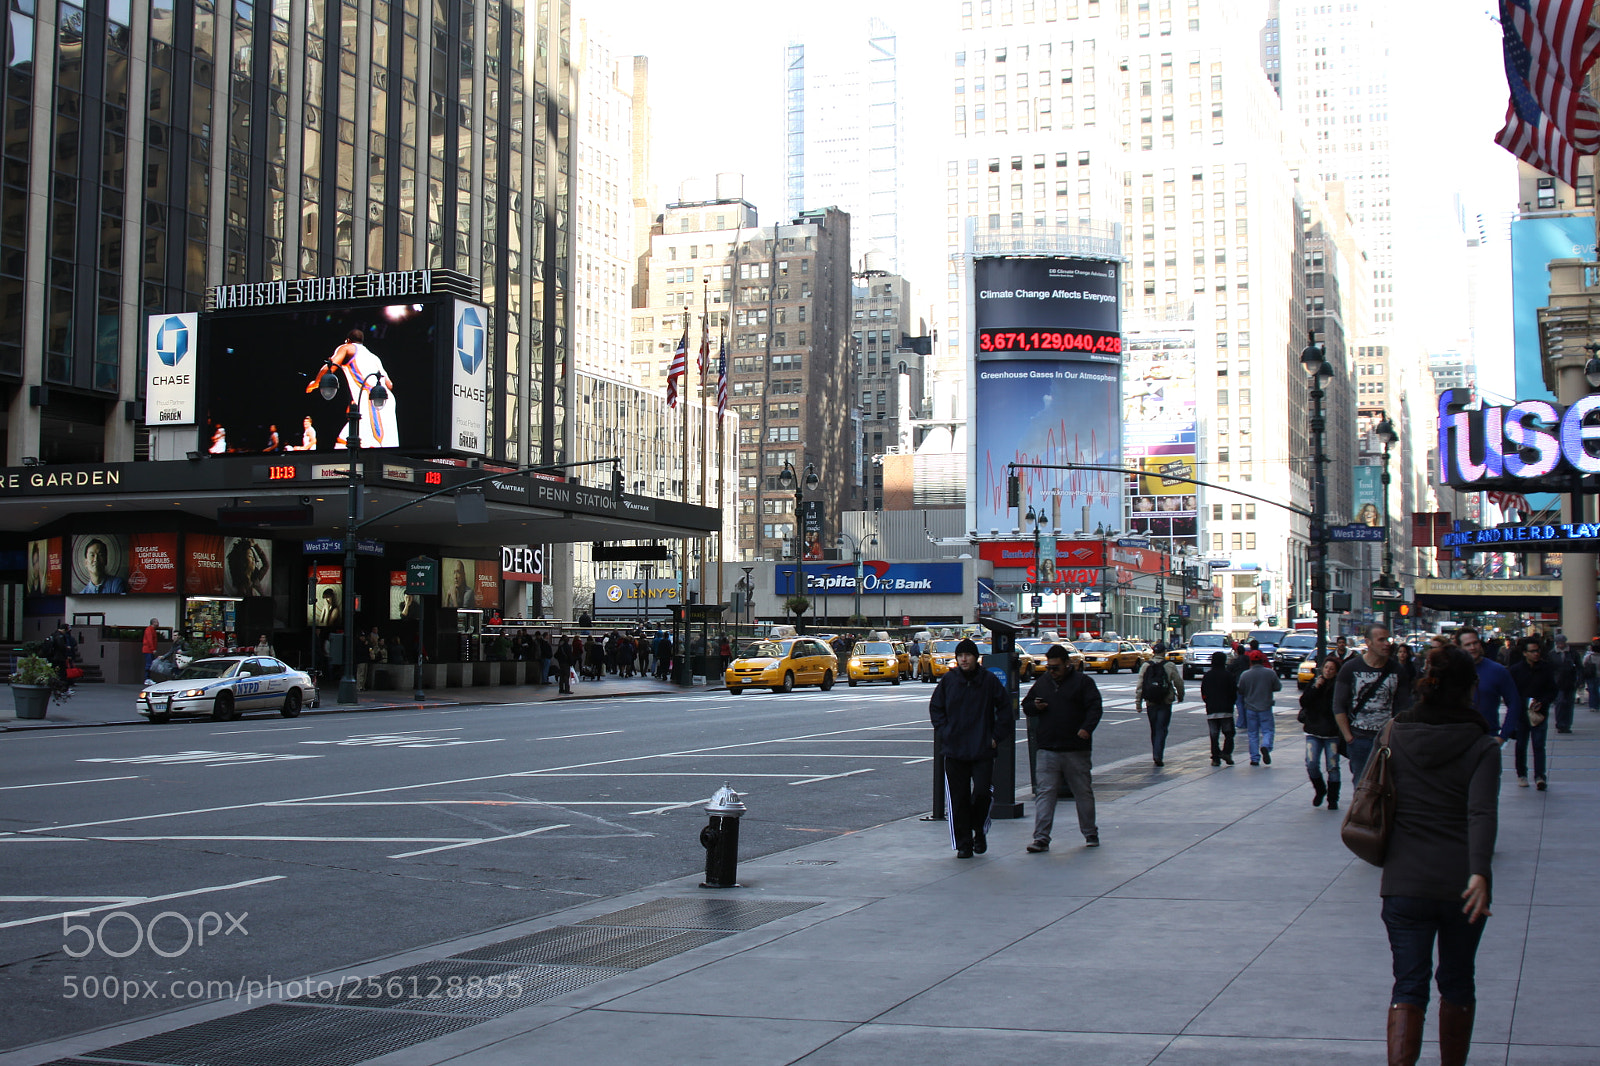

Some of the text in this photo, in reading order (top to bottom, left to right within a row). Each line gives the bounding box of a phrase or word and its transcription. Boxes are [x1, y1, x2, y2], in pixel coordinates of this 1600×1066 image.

[216, 269, 432, 309] MADISON SQUARE GARDEN
[980, 289, 1117, 303] Climate Change Affects Everyone
[980, 332, 1122, 353] 3,671,129,040,428
[152, 374, 190, 386] CHASE
[980, 370, 1117, 382] Greenhouse Gases In Our Atmosphere
[453, 384, 485, 403] CHASE
[30, 470, 120, 487] GARDEN
[269, 466, 295, 480] 11:13
[501, 484, 525, 493] AMTRAK
[538, 486, 617, 510] PENN STATION
[630, 503, 650, 511] AMTRAK
[1333, 529, 1354, 538] West
[1373, 529, 1381, 538] St
[1477, 528, 1501, 543] AND
[1505, 525, 1560, 541] N.E.R.D.
[305, 542, 321, 551] West
[334, 542, 341, 550] St
[192, 551, 210, 560] SIGNAL
[1002, 549, 1024, 559] Bank
[1024, 549, 1034, 559] of
[807, 574, 932, 590] Capita One Bank
[1026, 565, 1100, 587] Sway
[626, 588, 677, 599] LENNY'S
[1431, 582, 1549, 592] HOTEL PENNSYLVANIA
[1001, 635, 1008, 650] P
[237, 682, 260, 695] NYPD
